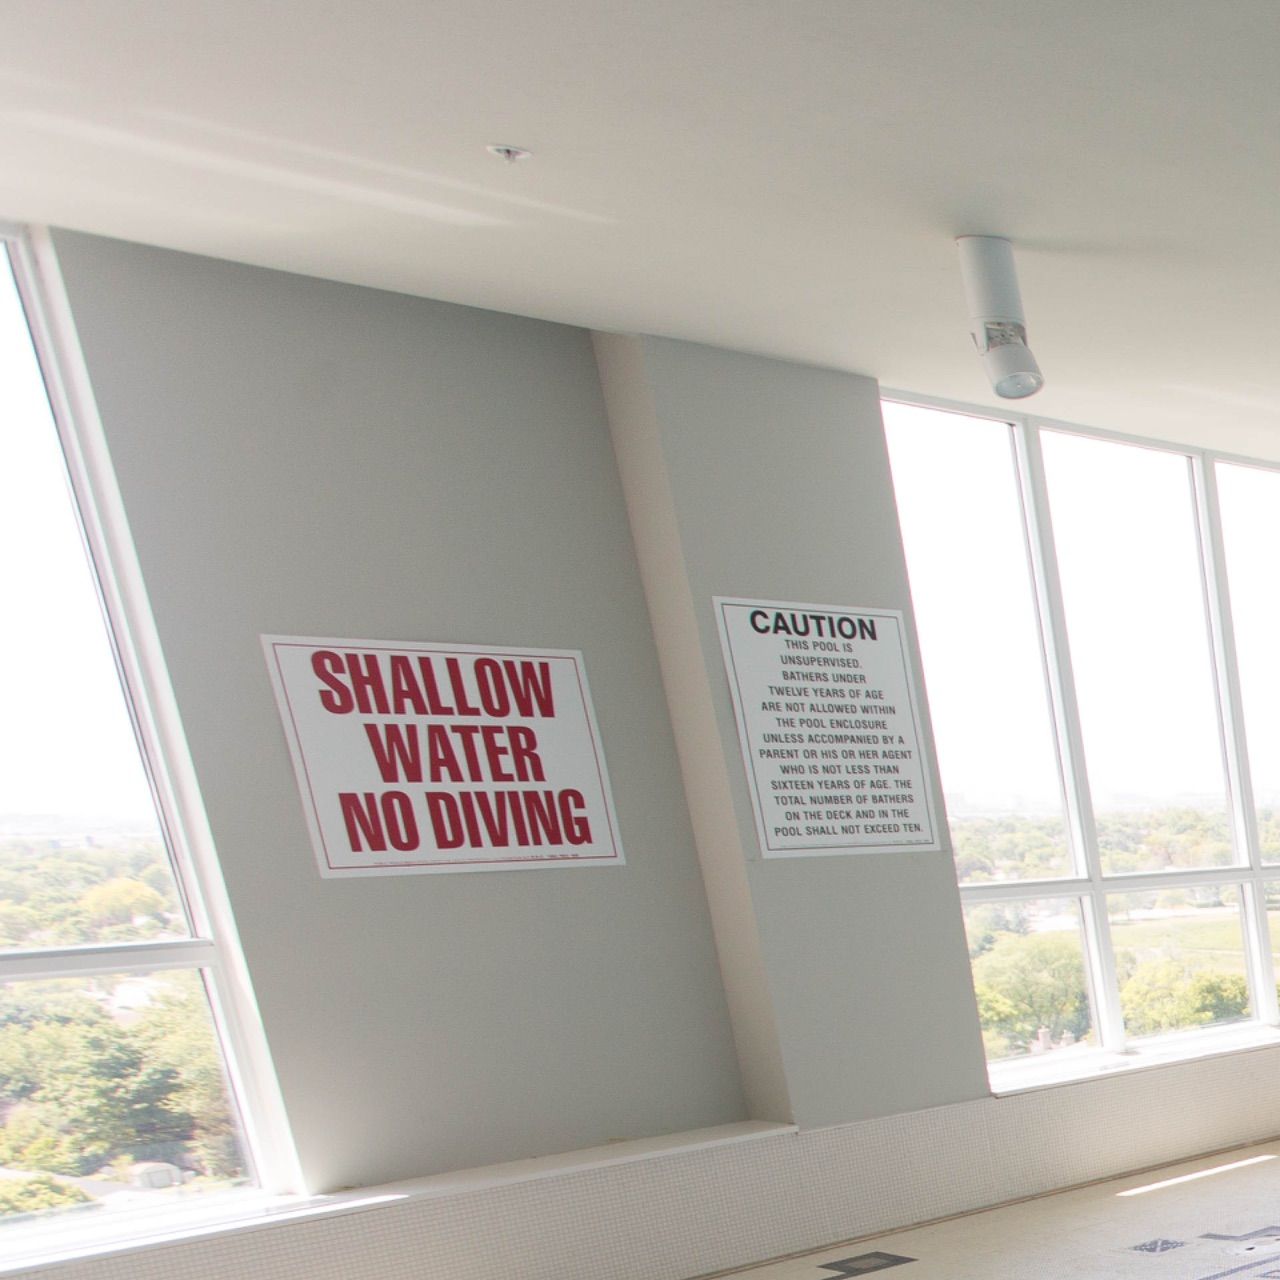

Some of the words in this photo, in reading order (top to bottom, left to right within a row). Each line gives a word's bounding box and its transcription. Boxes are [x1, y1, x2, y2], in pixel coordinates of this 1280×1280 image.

[750, 610, 877, 641] CAUTION
[785, 639, 809, 651] THIS
[813, 641, 839, 652] POOL
[843, 643, 853, 653] IS
[780, 655, 862, 669] UNSUPERVISED.
[311, 650, 555, 718] SHALLOW
[782, 671, 829, 682] BATHERS
[833, 673, 866, 684] UNDER
[768, 686, 809, 698] TWELVE
[813, 688, 845, 699] YEARS
[849, 689, 861, 699] OF
[865, 690, 884, 700] AGE
[761, 702, 782, 712] ARE
[786, 703, 805, 713] NOT
[810, 703, 857, 714] ALLOWED
[860, 705, 896, 715] WITHIN
[776, 718, 796, 728] THE
[800, 718, 826, 729] POOL
[830, 719, 888, 730] ENCLOSURE
[763, 734, 804, 744] UNLESS
[808, 735, 879, 745] ACCOMPANIED
[882, 735, 894, 745] BY
[898, 736, 905, 745] A
[364, 723, 546, 783] WATER
[759, 749, 801, 759] PARENT
[803, 749, 818, 759] OR
[821, 750, 838, 759] HIS
[841, 750, 856, 759] OR
[859, 750, 879, 760] HER
[882, 750, 912, 760] AGENT
[780, 765, 805, 775] WHO
[808, 765, 819, 775] IS
[822, 765, 842, 774] NOT
[846, 765, 870, 774] LESS
[873, 765, 899, 774] THAN
[770, 780, 814, 790] SIXTEEN
[817, 780, 850, 789] YEARS
[854, 780, 867, 789] OF
[870, 780, 891, 789] AGE.
[895, 779, 912, 789] THE
[774, 796, 807, 806] TOTAL
[809, 795, 852, 805] NUMBER
[856, 795, 868, 804] OF
[872, 795, 914, 804] BATHERS
[338, 791, 420, 852] NO
[425, 789, 593, 849] DIVING
[785, 811, 801, 821] ON
[803, 811, 823, 820] THE
[826, 810, 852, 820] DECK
[855, 810, 875, 819] AND
[878, 809, 889, 818] IN
[892, 809, 909, 818] THE
[774, 827, 802, 837] POOL
[806, 826, 838, 836] SHALL
[841, 825, 860, 834] NOT
[864, 824, 899, 834] EXCEED
[903, 823, 923, 833] TEN.
